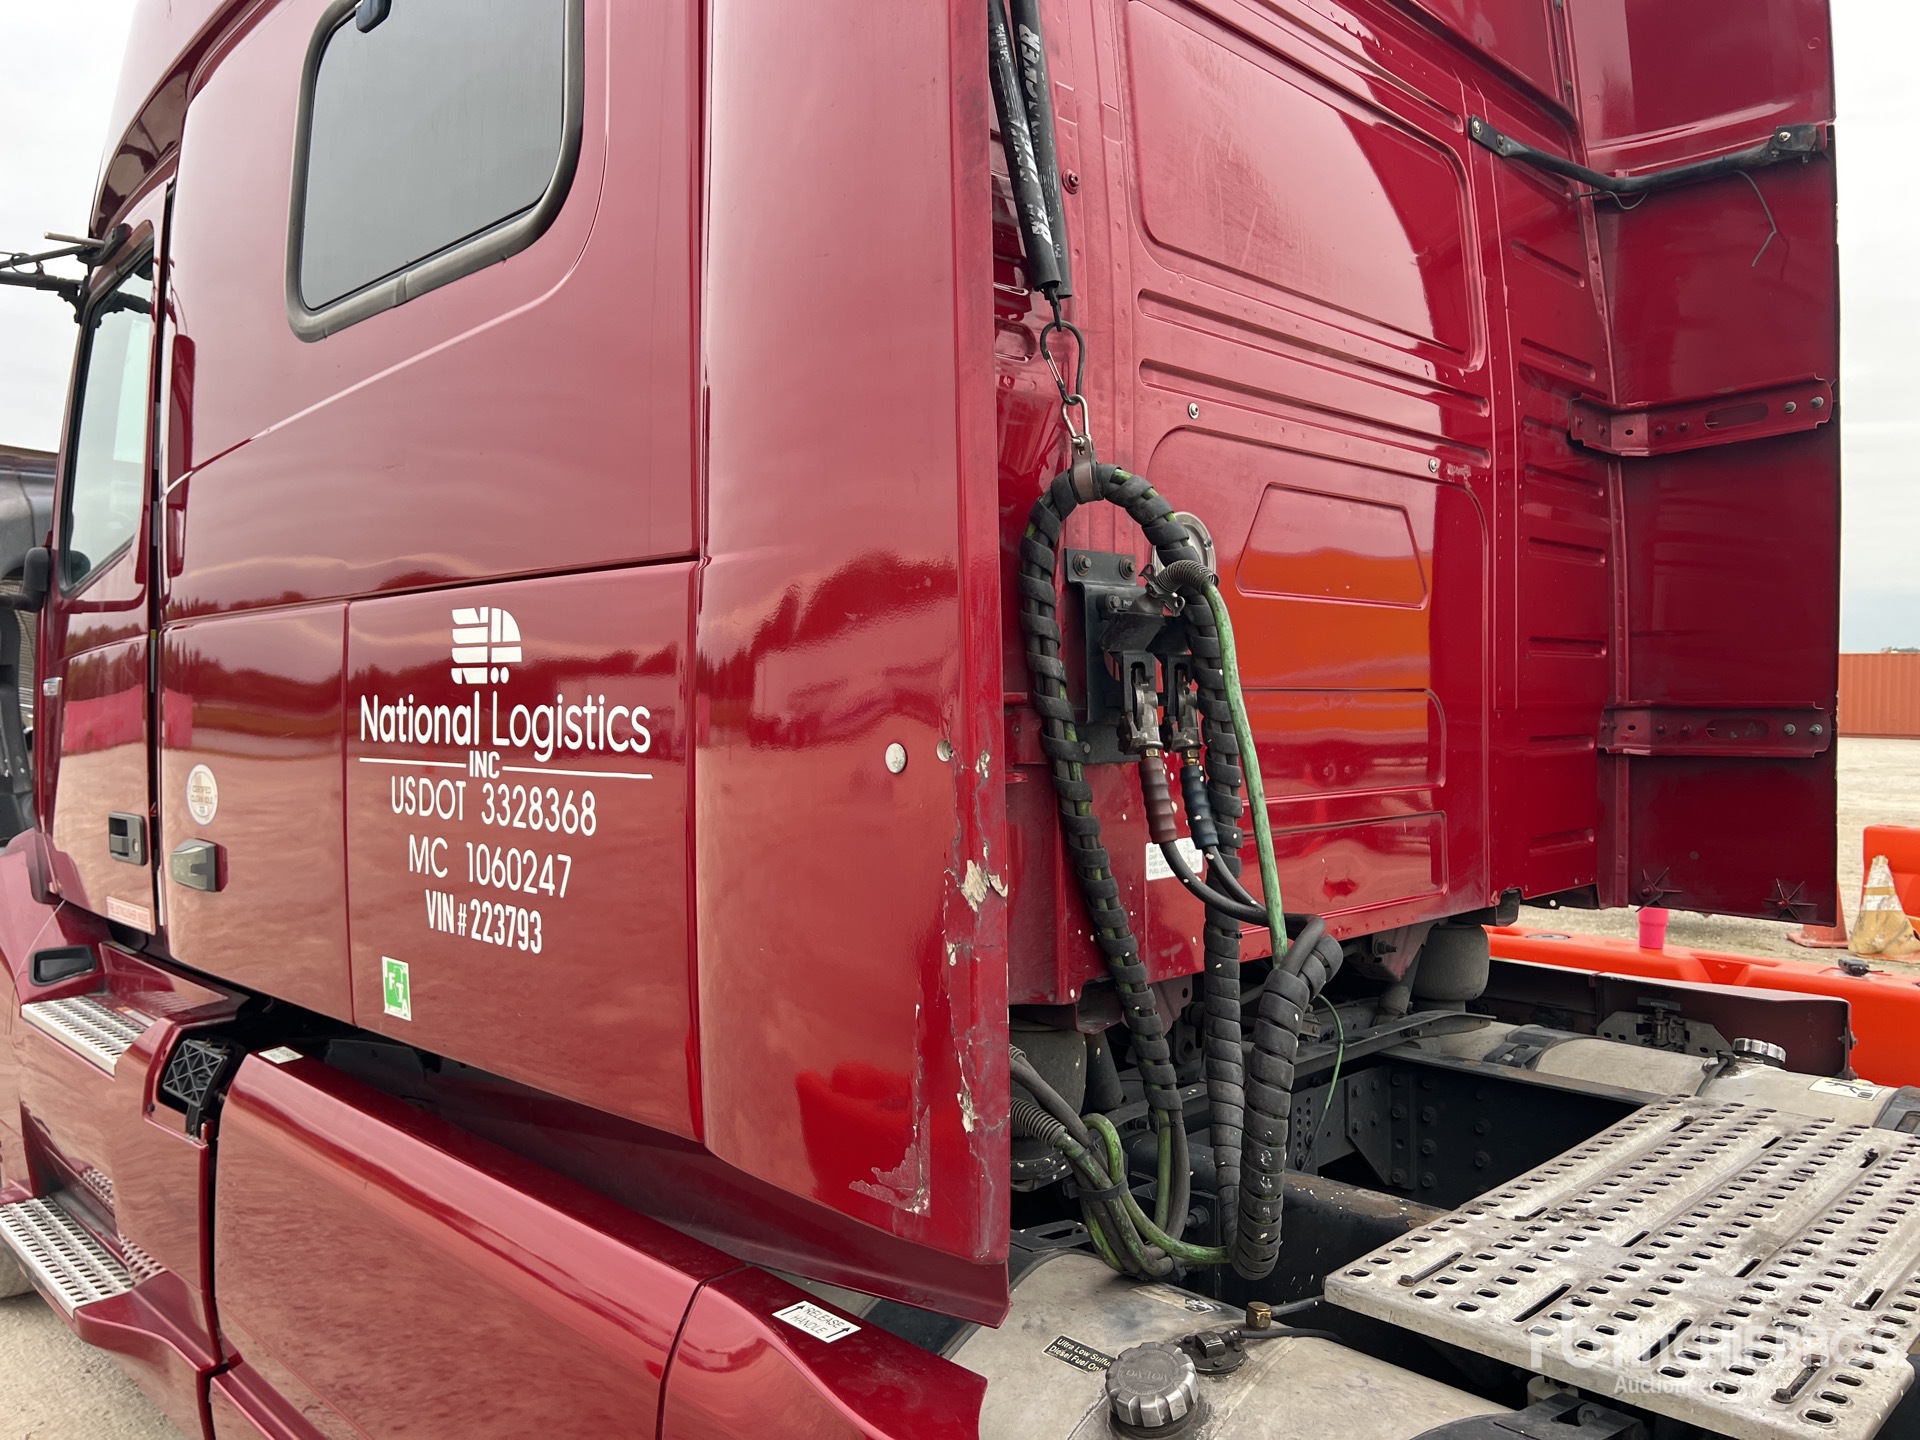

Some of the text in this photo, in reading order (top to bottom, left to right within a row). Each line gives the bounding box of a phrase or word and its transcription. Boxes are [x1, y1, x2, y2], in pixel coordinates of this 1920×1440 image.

[360, 690, 651, 763] National Logistics
[469, 750, 500, 779] INC
[391, 776, 597, 837] USDOT 3328368
[409, 834, 573, 899] MC 1060247
[790, 1315, 828, 1334] HANDLE
[804, 1307, 845, 1329] RELEASE
[1049, 1345, 1073, 1359] Diesel
[1071, 1355, 1089, 1367] Fuel
[1057, 1338, 1111, 1367] Ultra Low Sulfu
